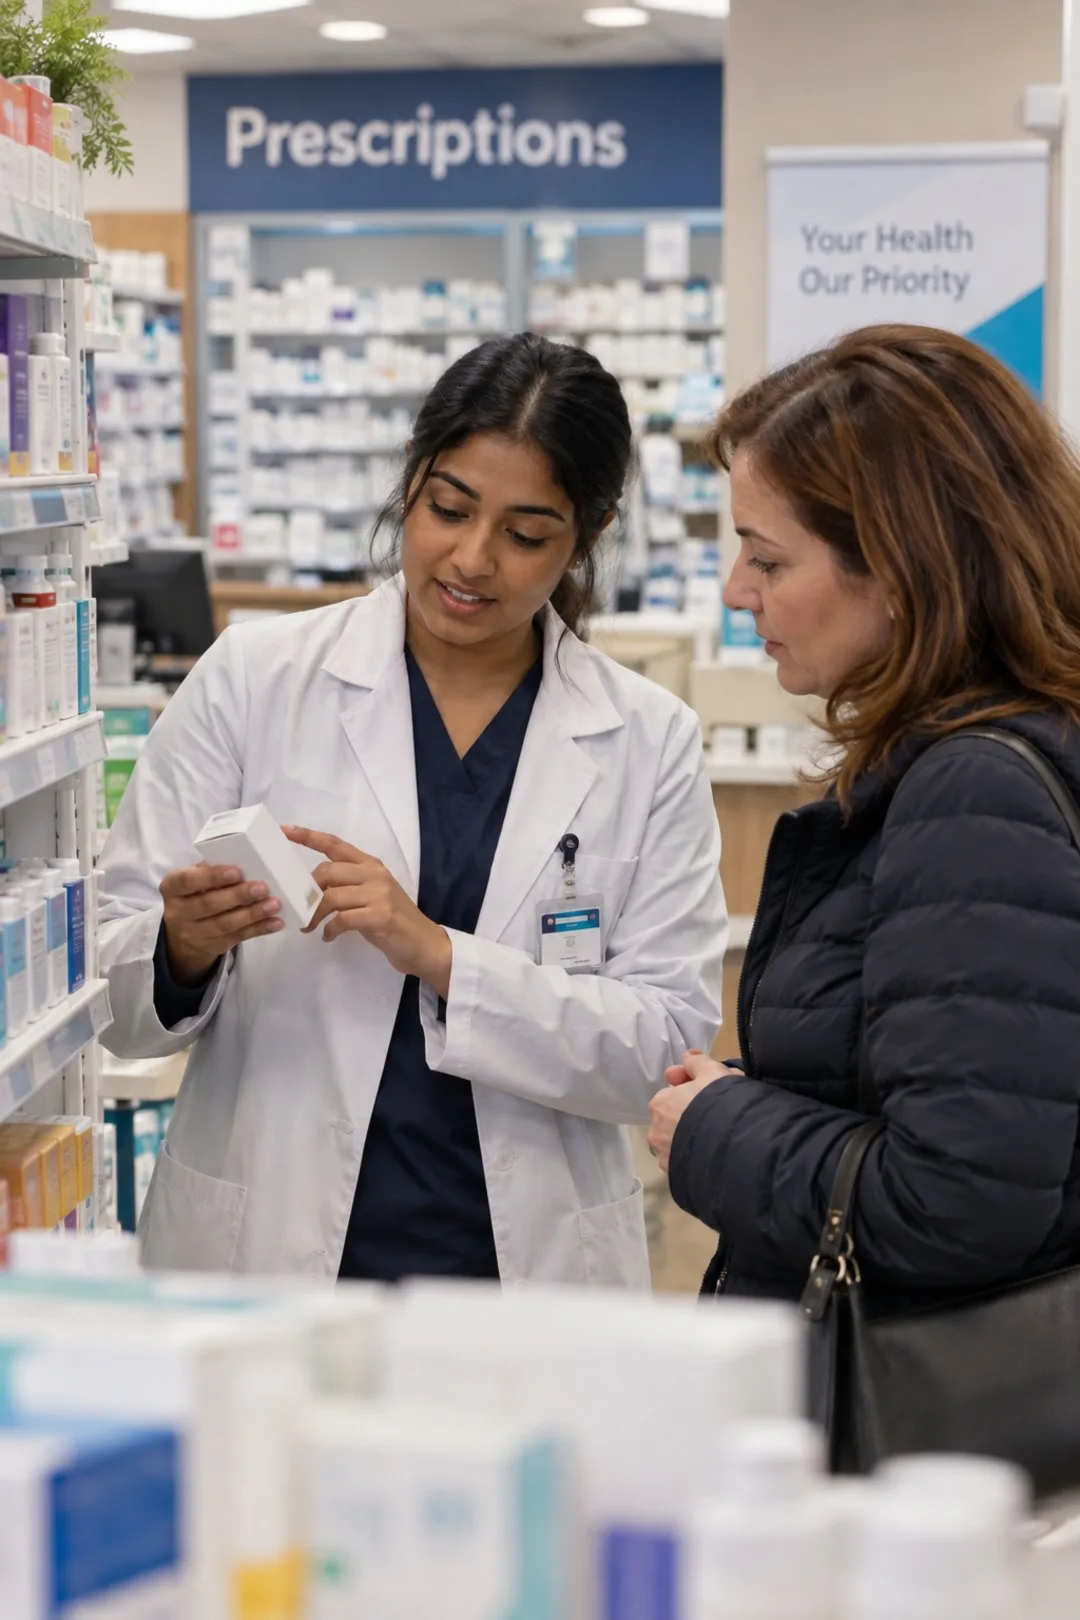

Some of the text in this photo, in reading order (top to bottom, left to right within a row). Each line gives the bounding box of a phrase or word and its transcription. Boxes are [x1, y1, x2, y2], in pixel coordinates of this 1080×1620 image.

[226, 103, 627, 180] Prescriptions
[800, 220, 974, 254] Your Health
[799, 264, 971, 302] Our Priority
